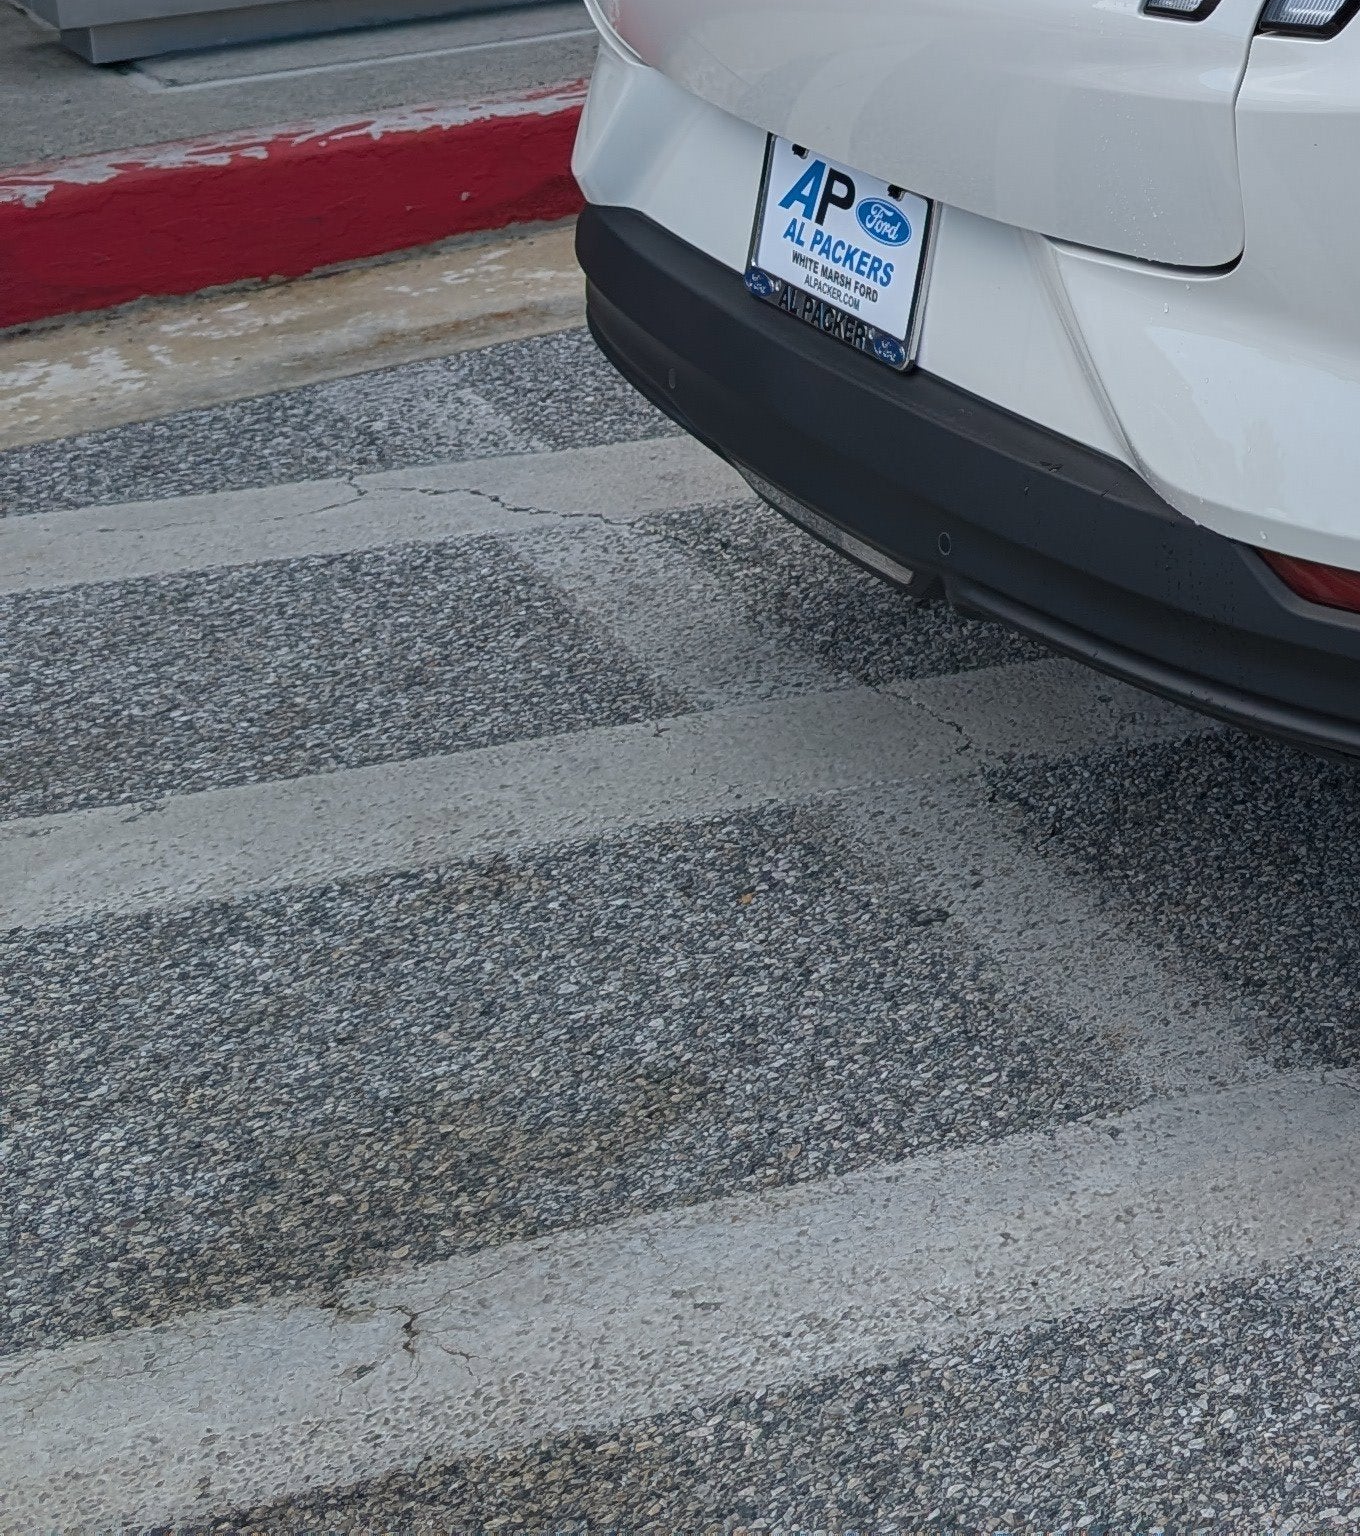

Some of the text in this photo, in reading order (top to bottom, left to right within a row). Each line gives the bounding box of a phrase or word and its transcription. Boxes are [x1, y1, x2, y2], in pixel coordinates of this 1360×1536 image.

[778, 159, 856, 226] AP
[865, 203, 899, 241] Ford
[783, 217, 895, 287] AL PACKERS
[792, 250, 878, 303] WHITE MARSH FORD
[778, 285, 868, 351] AL PACKER
[804, 274, 860, 311] ALPACKER.COM
